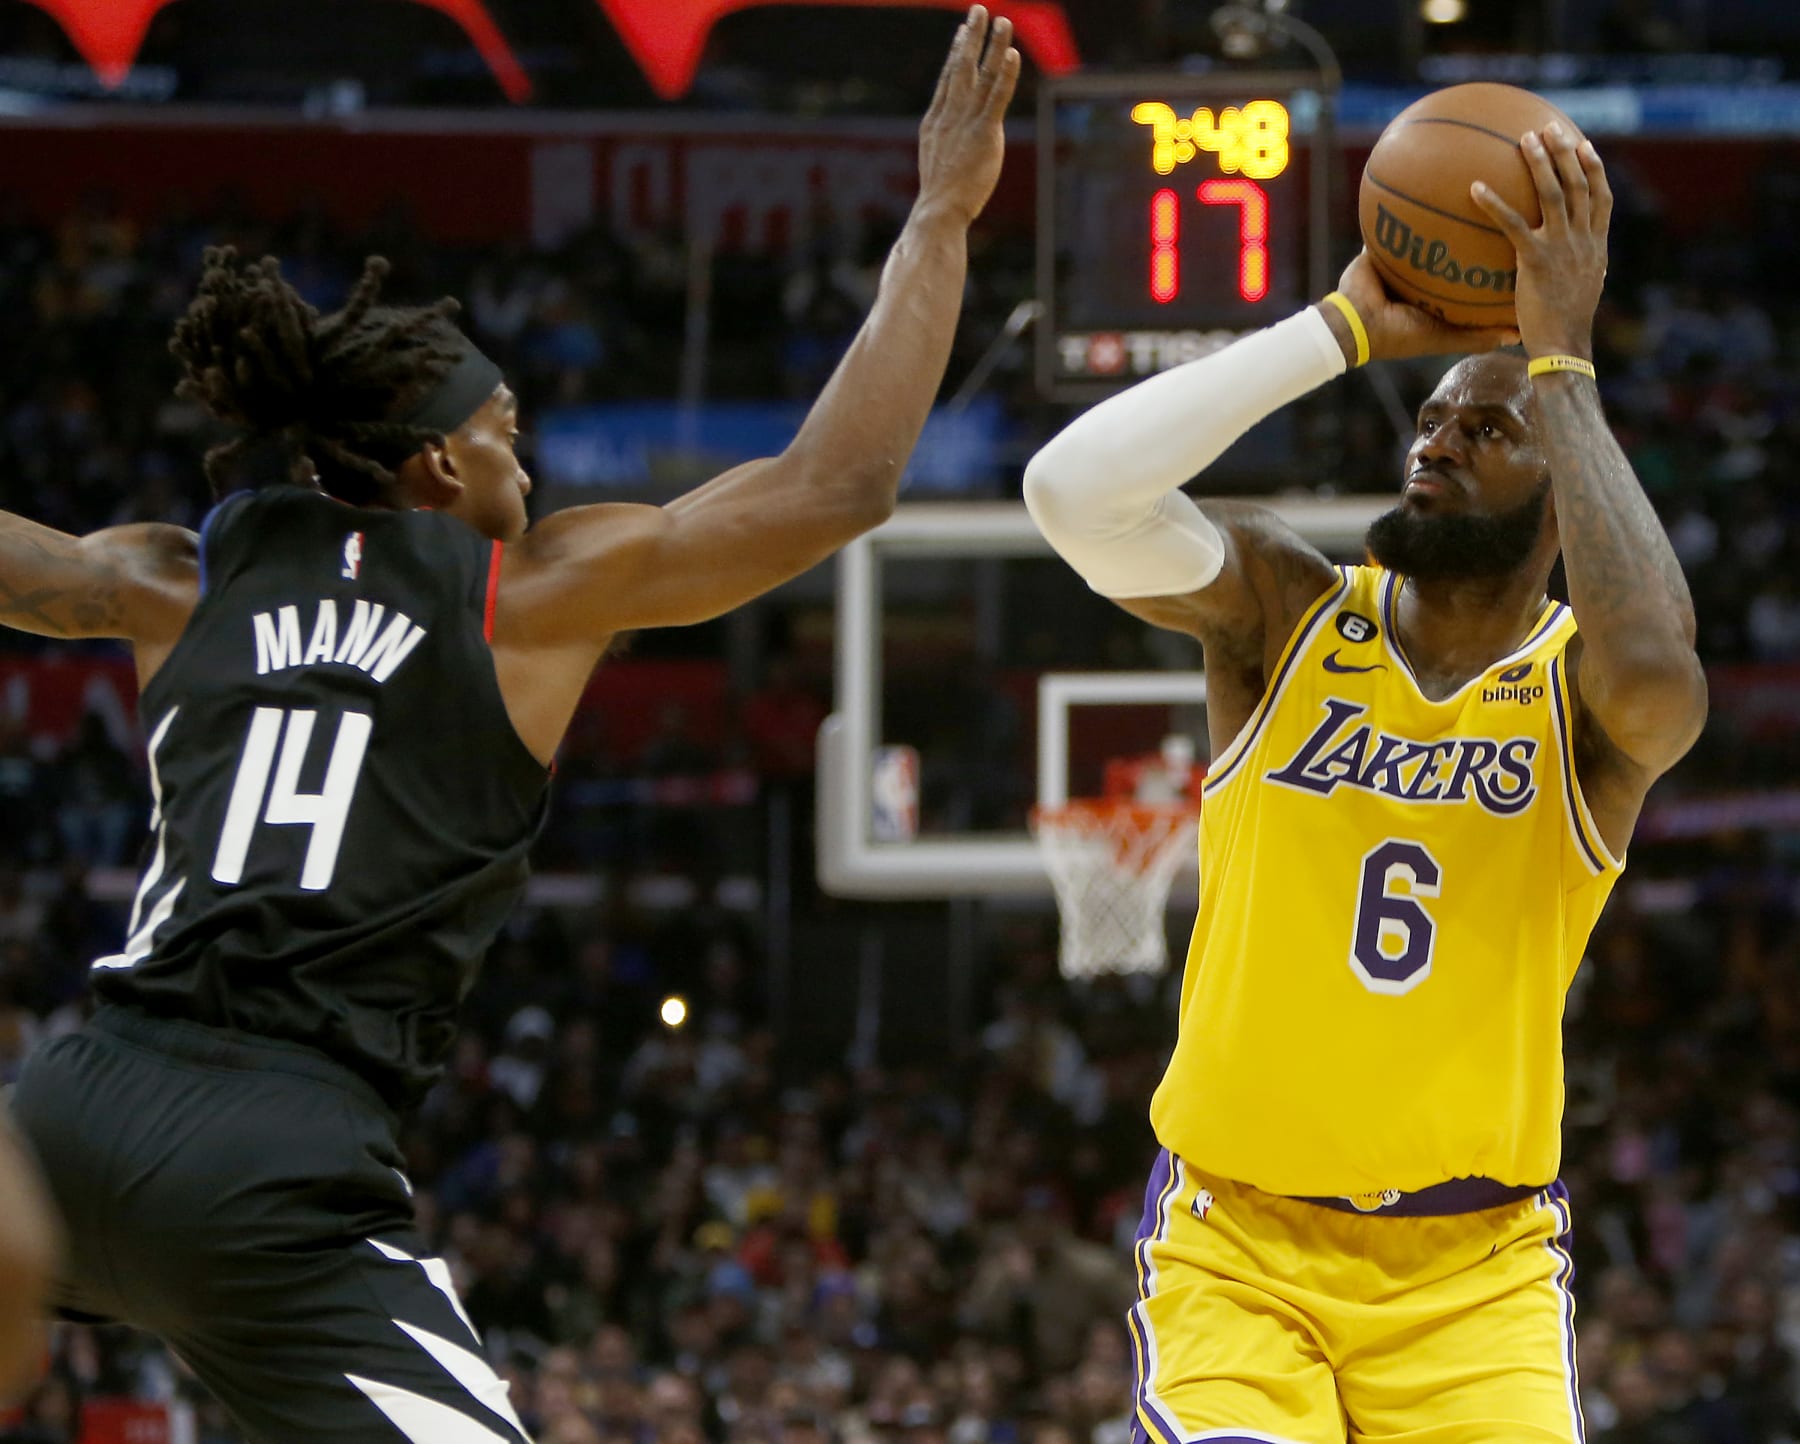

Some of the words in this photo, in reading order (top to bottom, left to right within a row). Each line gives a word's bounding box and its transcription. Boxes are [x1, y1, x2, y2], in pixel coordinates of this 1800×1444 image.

[1131, 100, 1289, 179] 7:48
[1151, 178, 1269, 303] 17
[1375, 201, 1516, 292] Wilson
[253, 599, 427, 683] MANN
[1342, 616, 1369, 641] 6
[1482, 684, 1544, 705] bibigo
[211, 706, 373, 890] 14
[1262, 696, 1540, 818] LAKERS
[1348, 836, 1444, 997] 6
